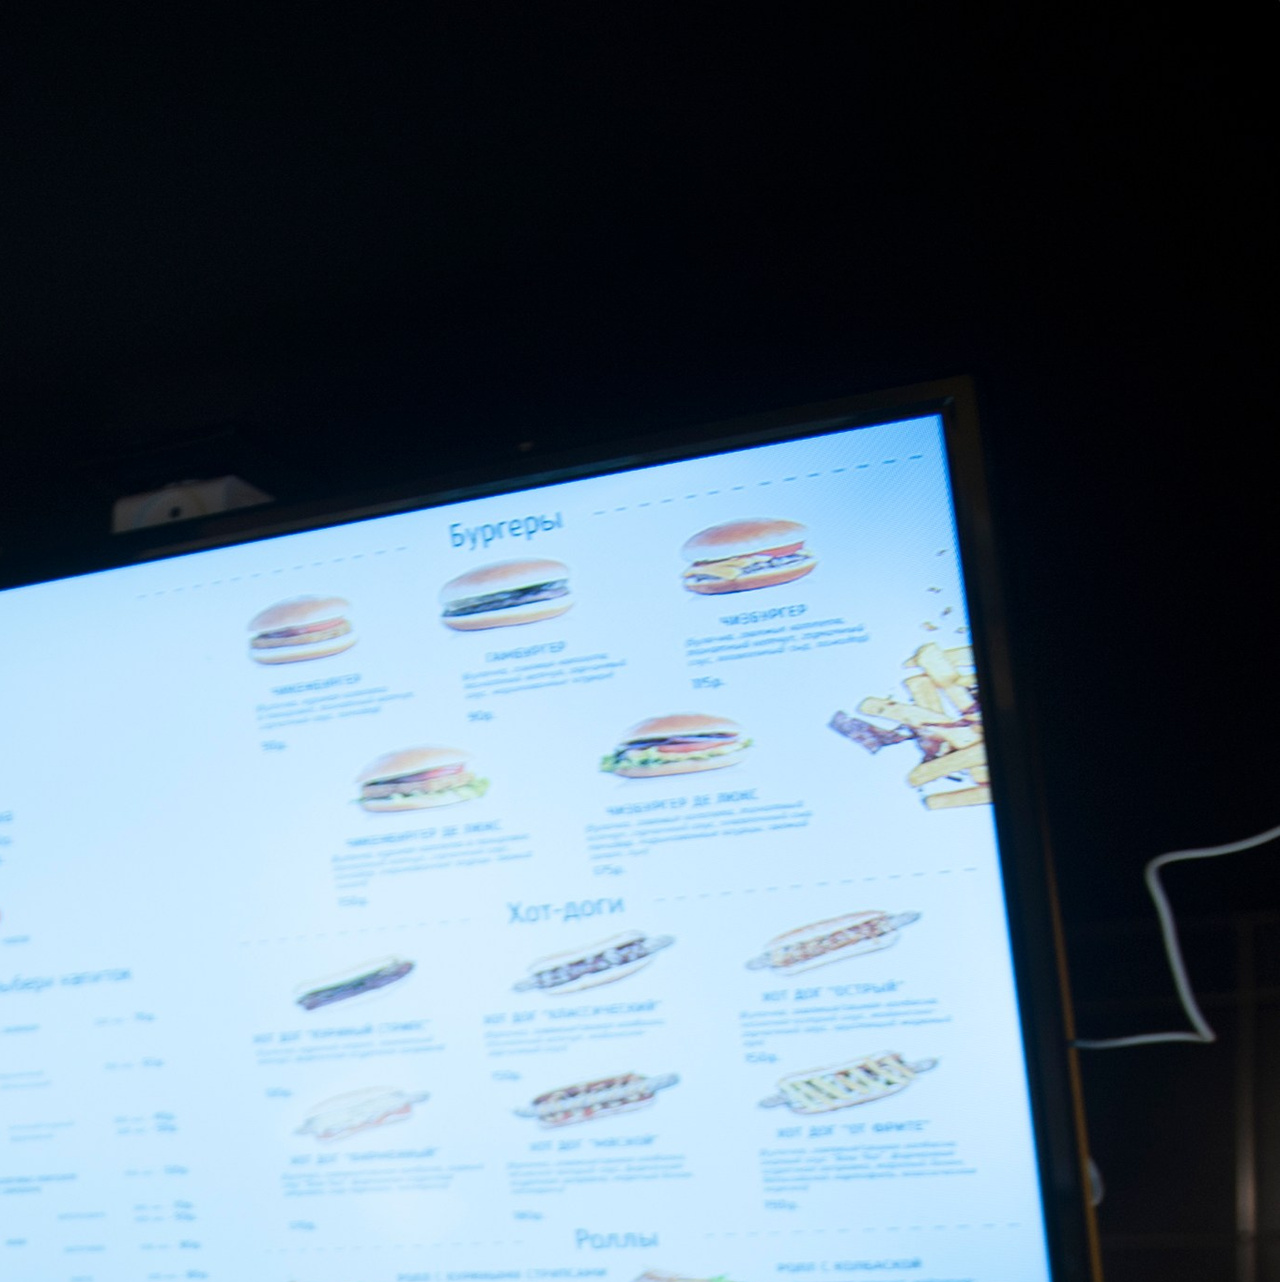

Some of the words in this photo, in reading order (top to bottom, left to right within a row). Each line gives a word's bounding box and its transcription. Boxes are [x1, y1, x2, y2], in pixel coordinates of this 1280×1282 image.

[450, 511, 564, 550] Бургеры
[505, 897, 626, 925] Хот-доги
[574, 1228, 659, 1250] Роллы
